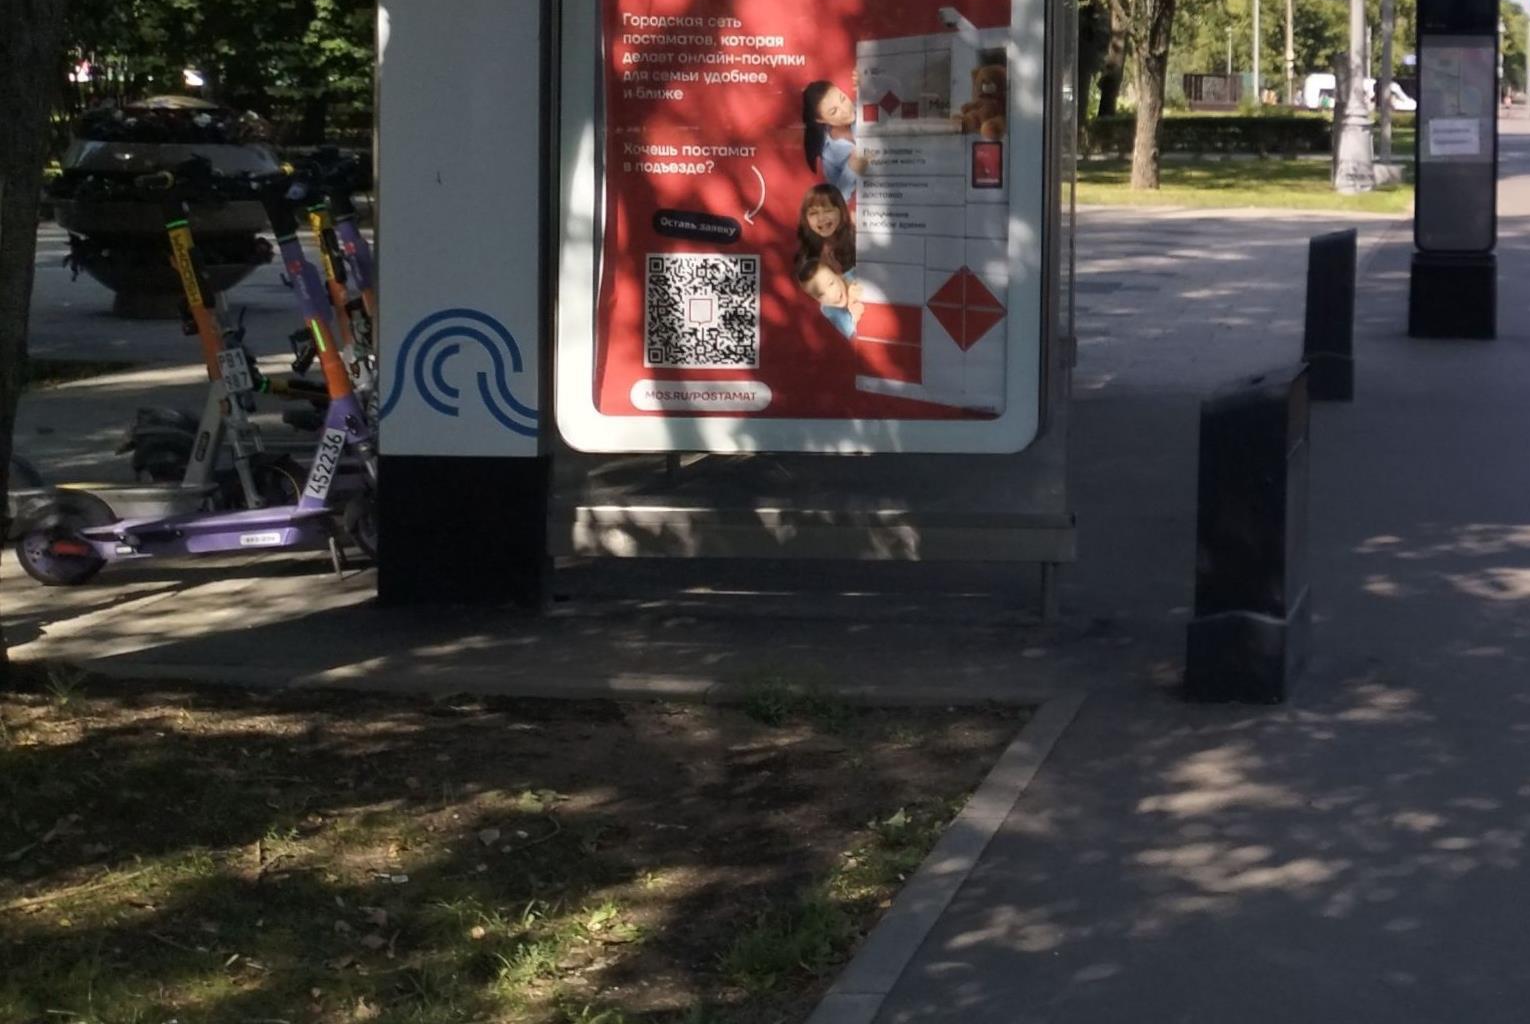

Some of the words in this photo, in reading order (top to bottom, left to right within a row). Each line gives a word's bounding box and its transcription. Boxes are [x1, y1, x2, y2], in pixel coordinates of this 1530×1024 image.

[622, 12, 704, 29] Городская
[708, 16, 742, 29] сеть
[622, 33, 718, 48] постаматов,
[721, 34, 784, 50] которая
[622, 51, 675, 65] делает
[678, 50, 806, 68] онлайн-покупки
[623, 70, 649, 83] для
[652, 71, 700, 83] семьи
[704, 69, 768, 85] удобнее
[623, 89, 633, 99] и
[636, 87, 684, 101] ближе
[623, 142, 678, 157] Хочешь
[682, 145, 757, 158] постамат
[623, 163, 632, 173] в
[635, 160, 715, 175] подъезде?
[660, 216, 697, 230] Оставь
[645, 391, 757, 402] MOS.RU/POSTAMAT
[308, 434, 343, 494] 452236
